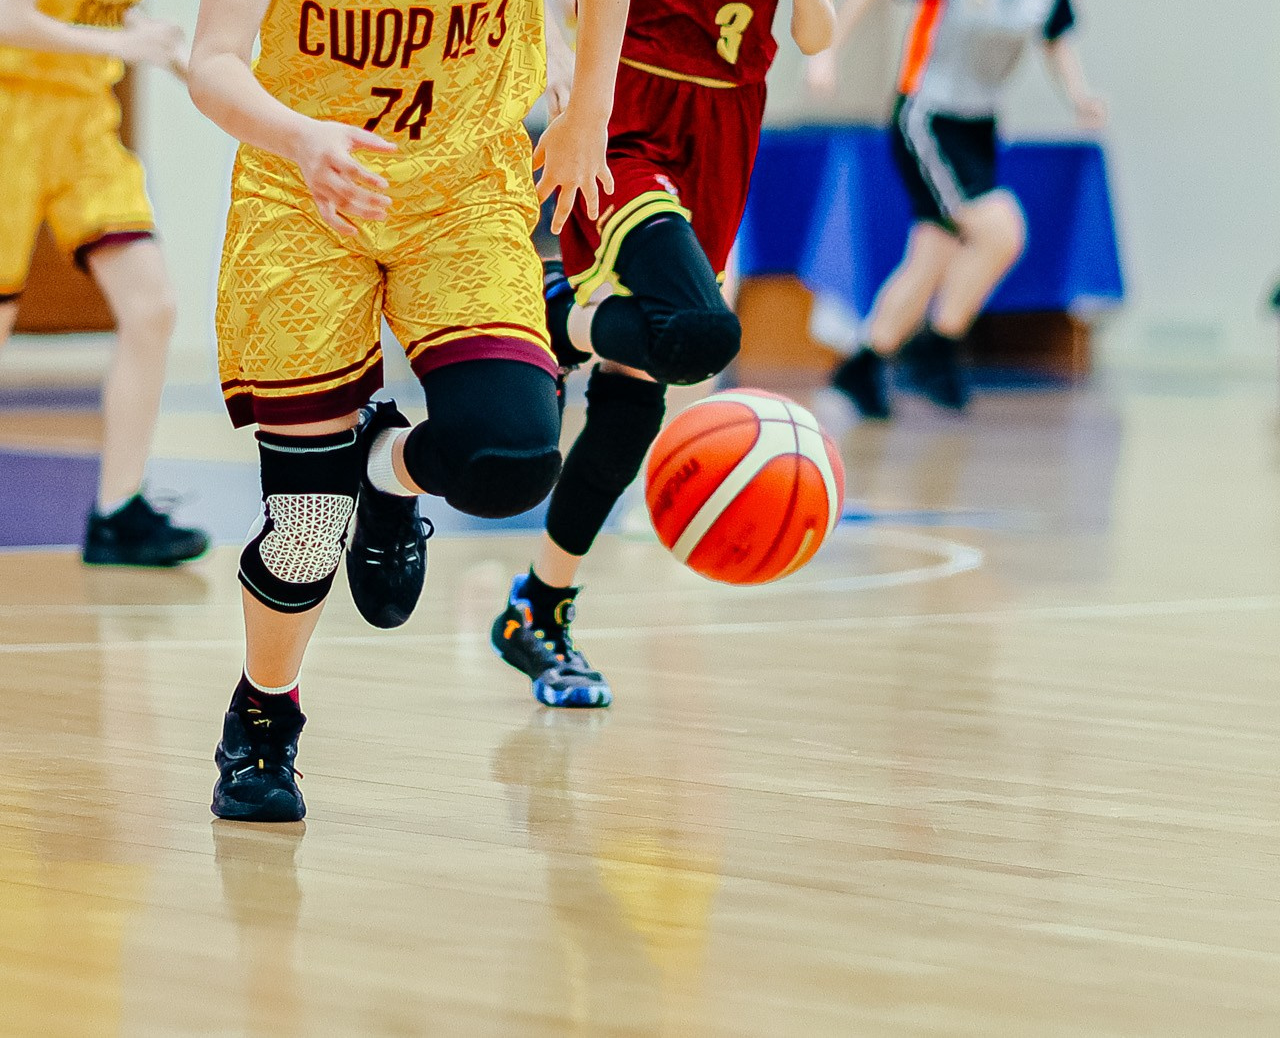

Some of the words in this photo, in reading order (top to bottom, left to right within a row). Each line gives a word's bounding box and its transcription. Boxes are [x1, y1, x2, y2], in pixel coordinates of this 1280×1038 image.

[298, 0, 434, 70] СШОР
[715, 2, 754, 64] 3
[362, 79, 435, 140] 74
